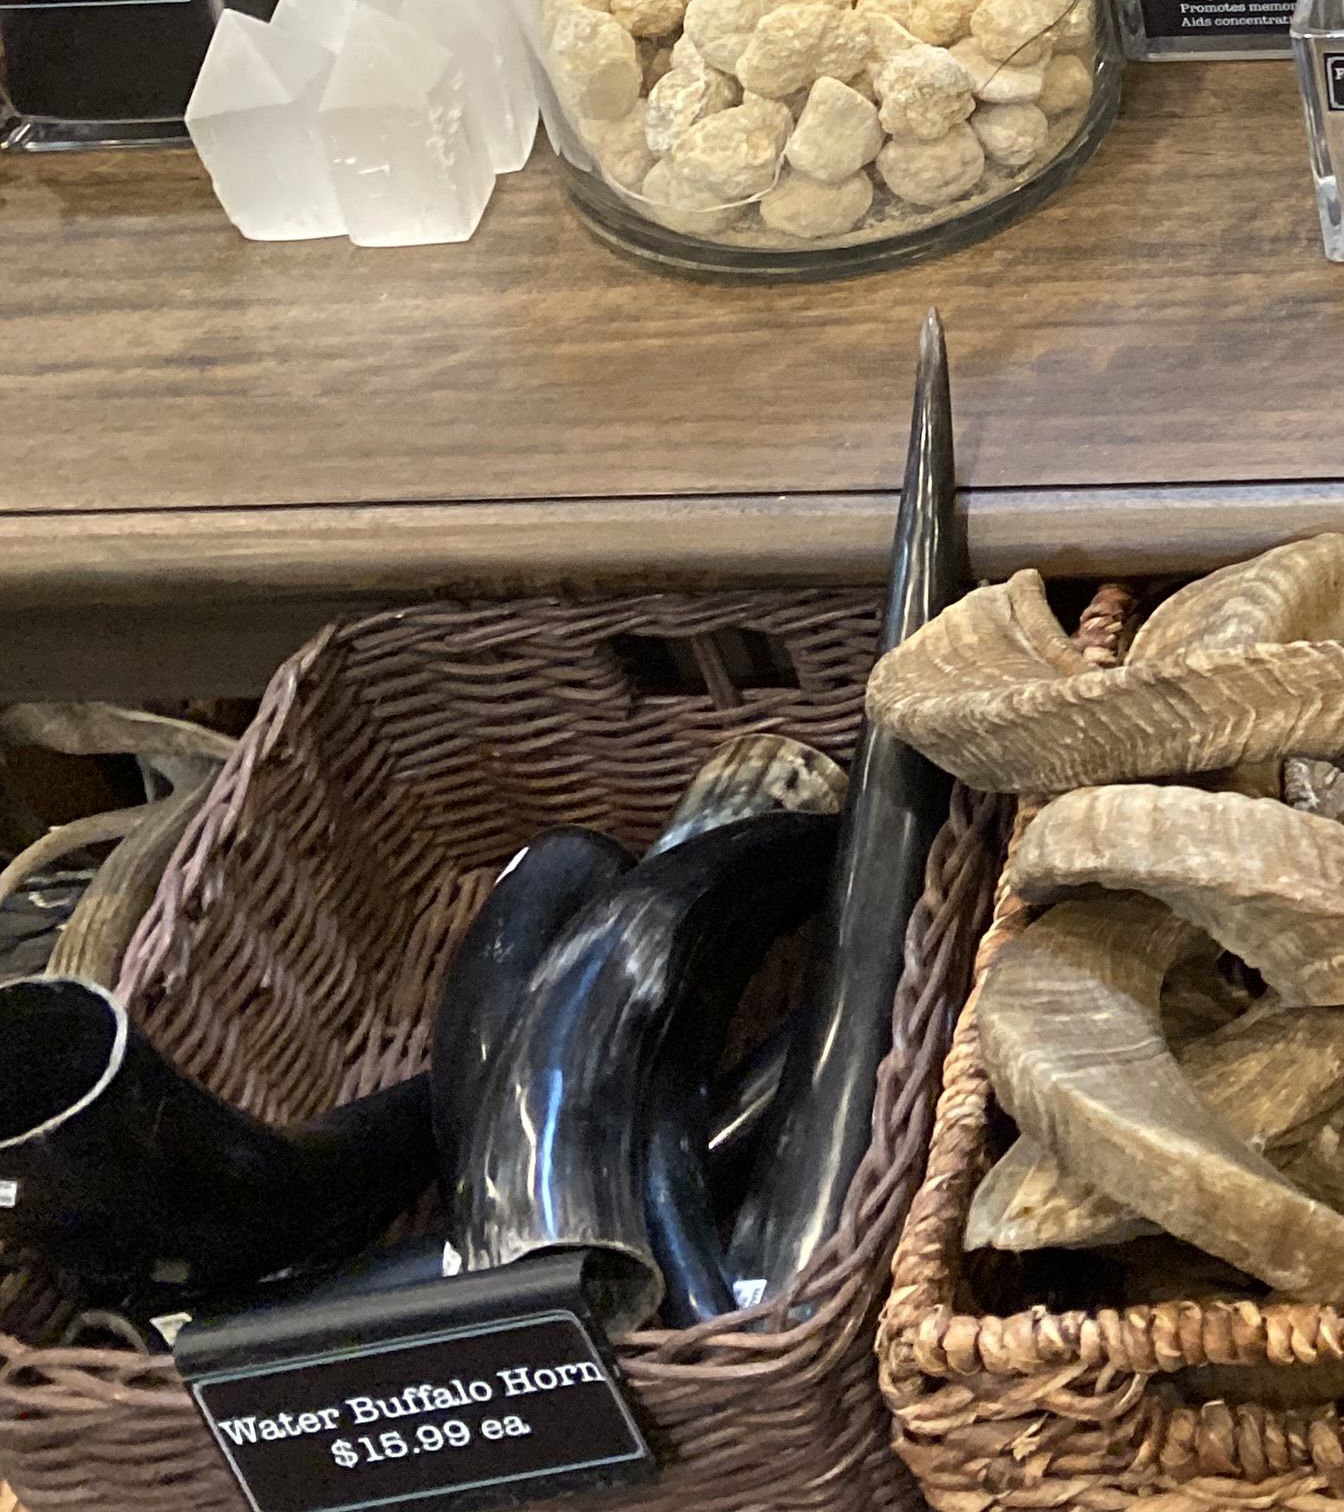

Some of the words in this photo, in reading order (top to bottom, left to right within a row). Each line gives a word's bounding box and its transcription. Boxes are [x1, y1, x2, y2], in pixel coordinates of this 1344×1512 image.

[1180, 3, 1246, 13] Promotes
[1250, 3, 1296, 11] memor
[1182, 17, 1212, 27] Aids
[219, 1406, 340, 1445] Water
[345, 1378, 493, 1426] Buffalo
[497, 1359, 606, 1397] Horn
[331, 1418, 472, 1468] $15.99
[480, 1414, 532, 1440] ea
